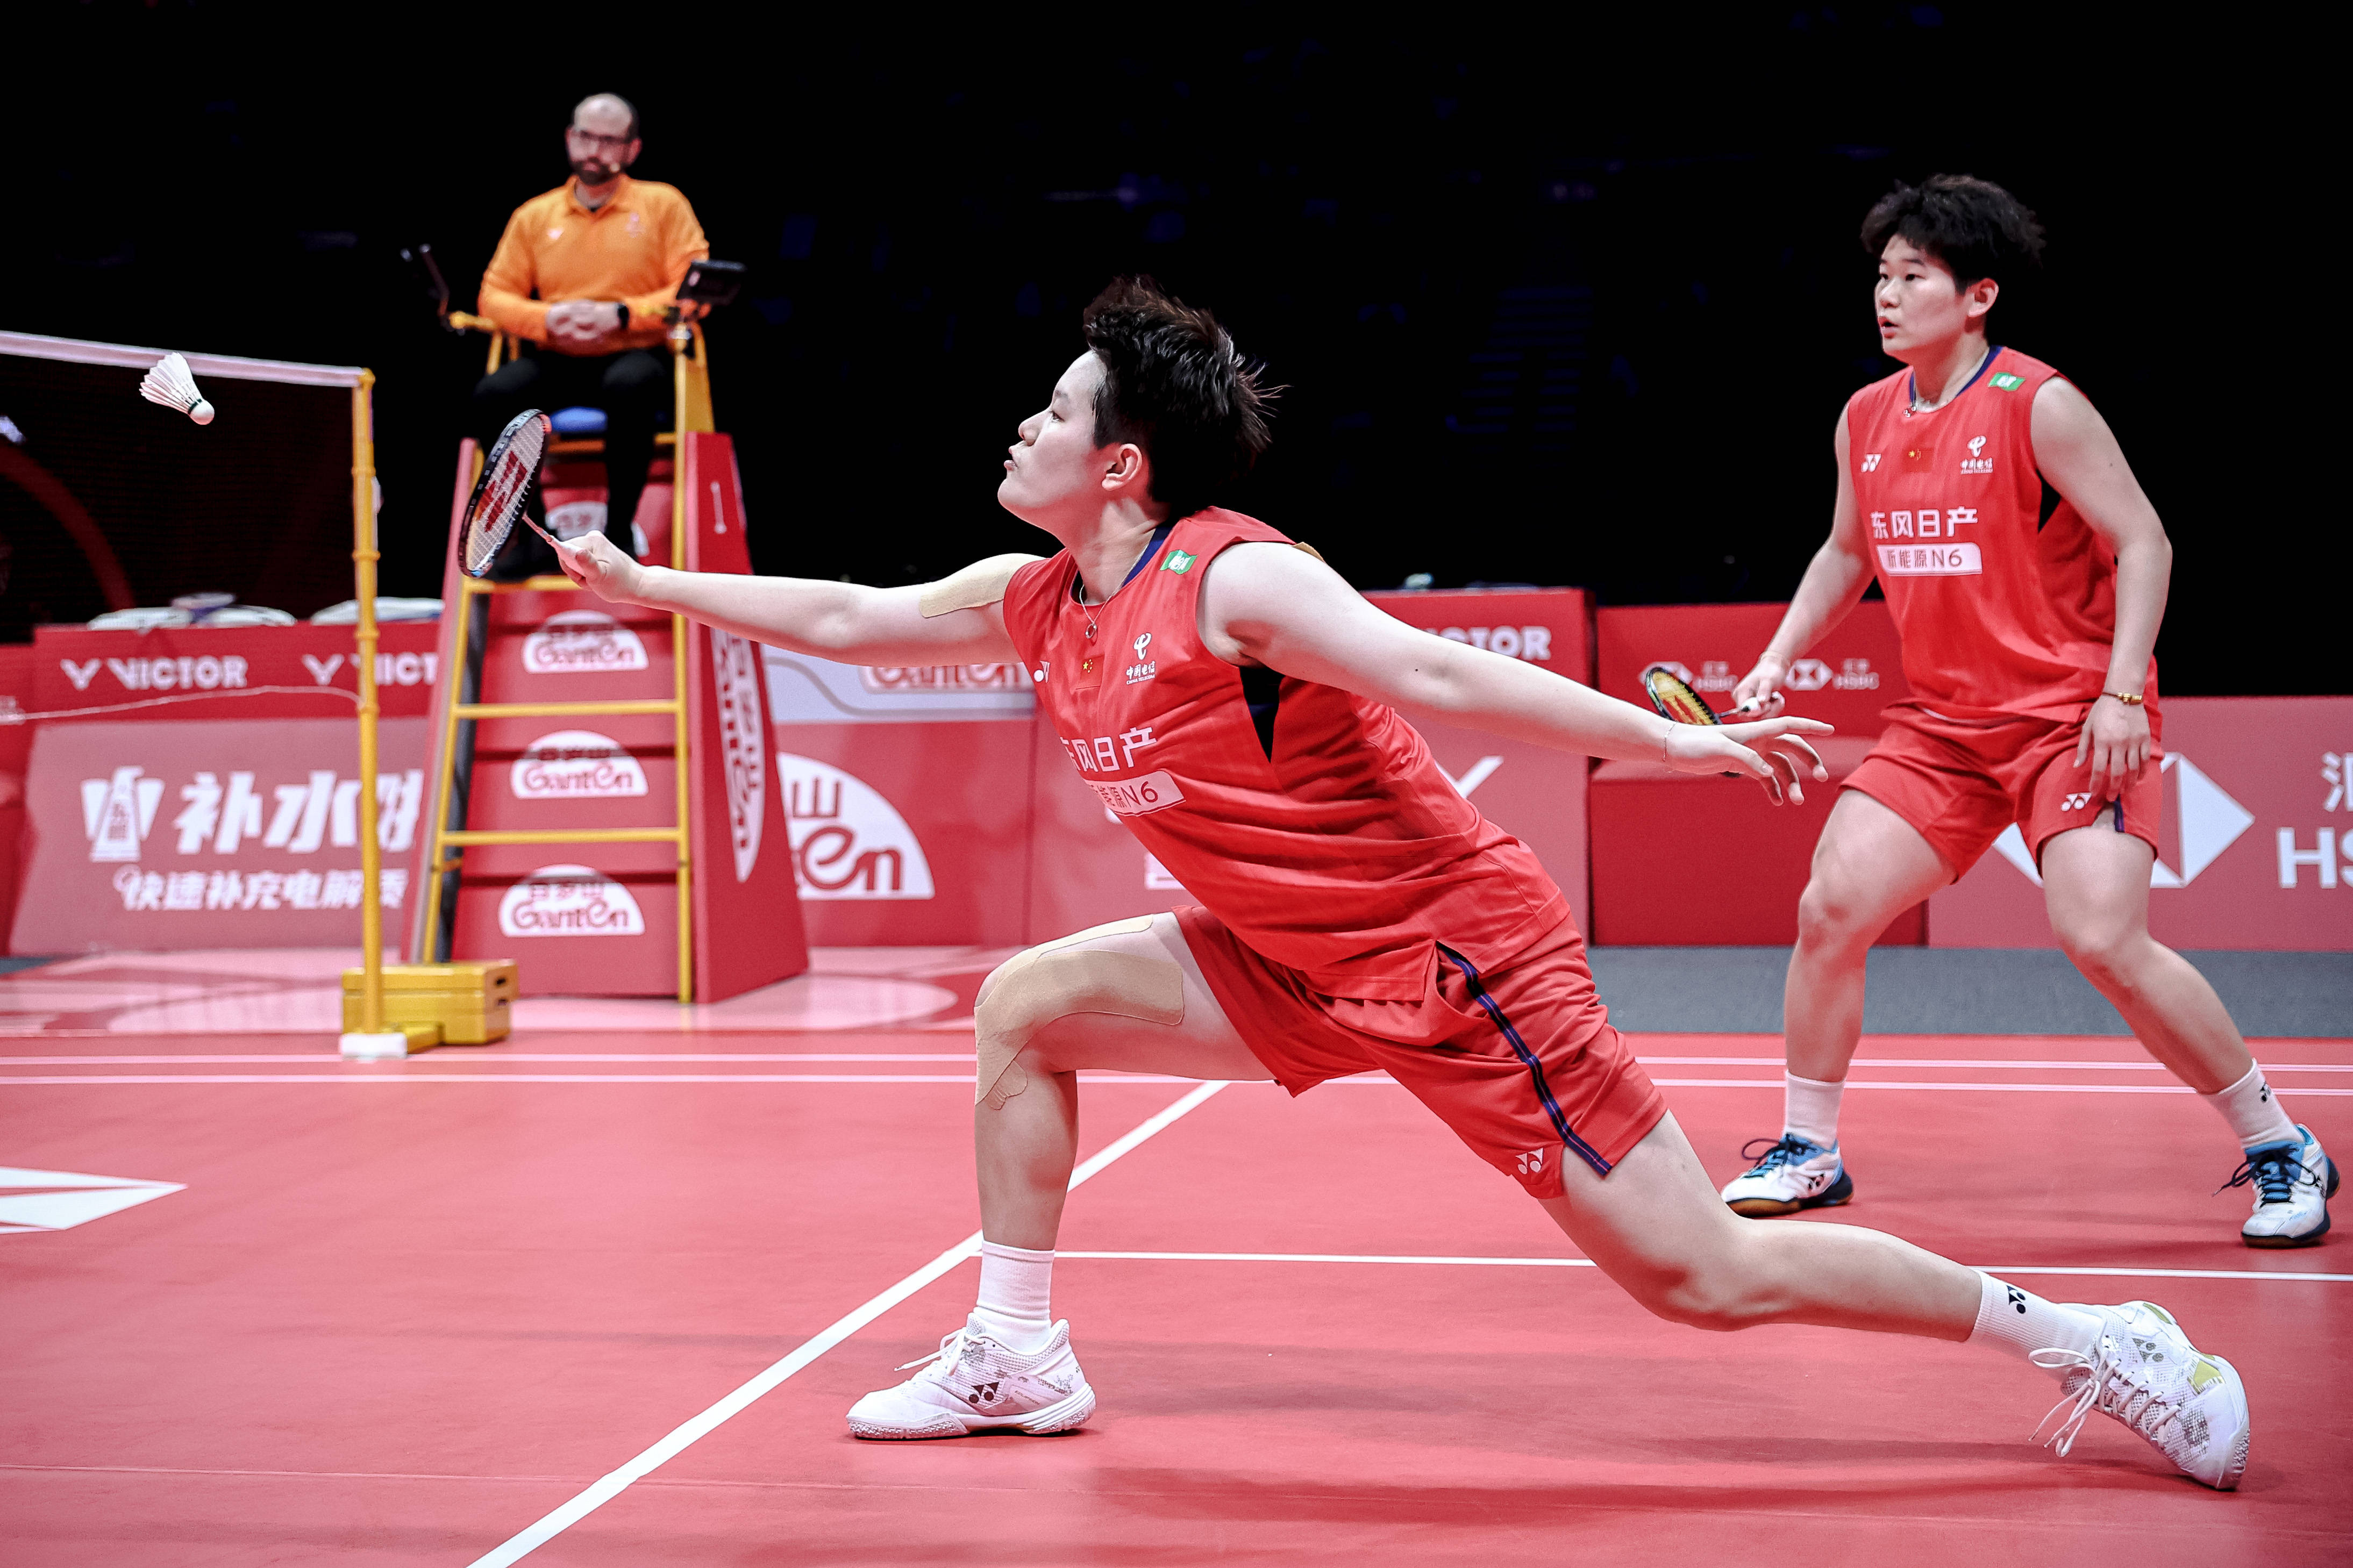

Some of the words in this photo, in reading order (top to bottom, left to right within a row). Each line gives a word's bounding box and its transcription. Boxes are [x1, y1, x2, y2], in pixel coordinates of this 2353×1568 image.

[1871, 506, 1978, 539] 东风日产
[106, 655, 248, 690] VICTOR
[2276, 827, 2353, 889] H
